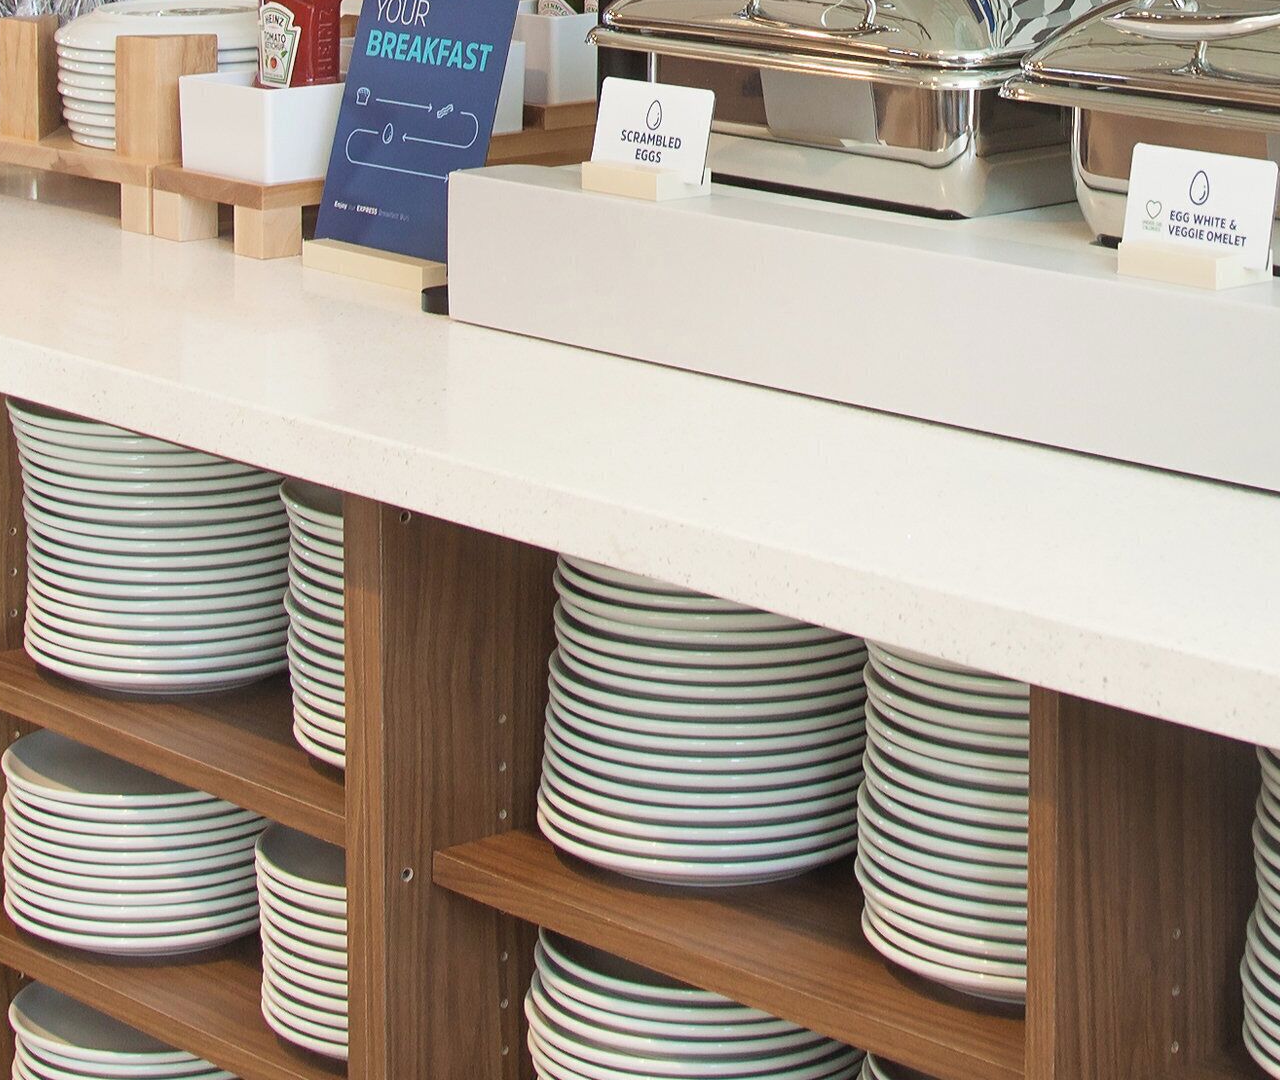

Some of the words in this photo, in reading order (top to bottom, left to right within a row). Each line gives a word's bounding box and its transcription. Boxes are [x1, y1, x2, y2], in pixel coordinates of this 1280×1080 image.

[265, 14, 285, 28] HEINZ
[264, 31, 287, 44] TOMATO
[365, 29, 494, 72] BREAKFAST
[621, 129, 682, 150] SCRAMBLED
[635, 148, 662, 164] EGGS
[1169, 210, 1190, 224] EGG
[1193, 214, 1226, 229] WHITE
[1229, 219, 1237, 231] &
[1168, 225, 1204, 240] VEGGIE
[1206, 231, 1247, 248] OMELET
